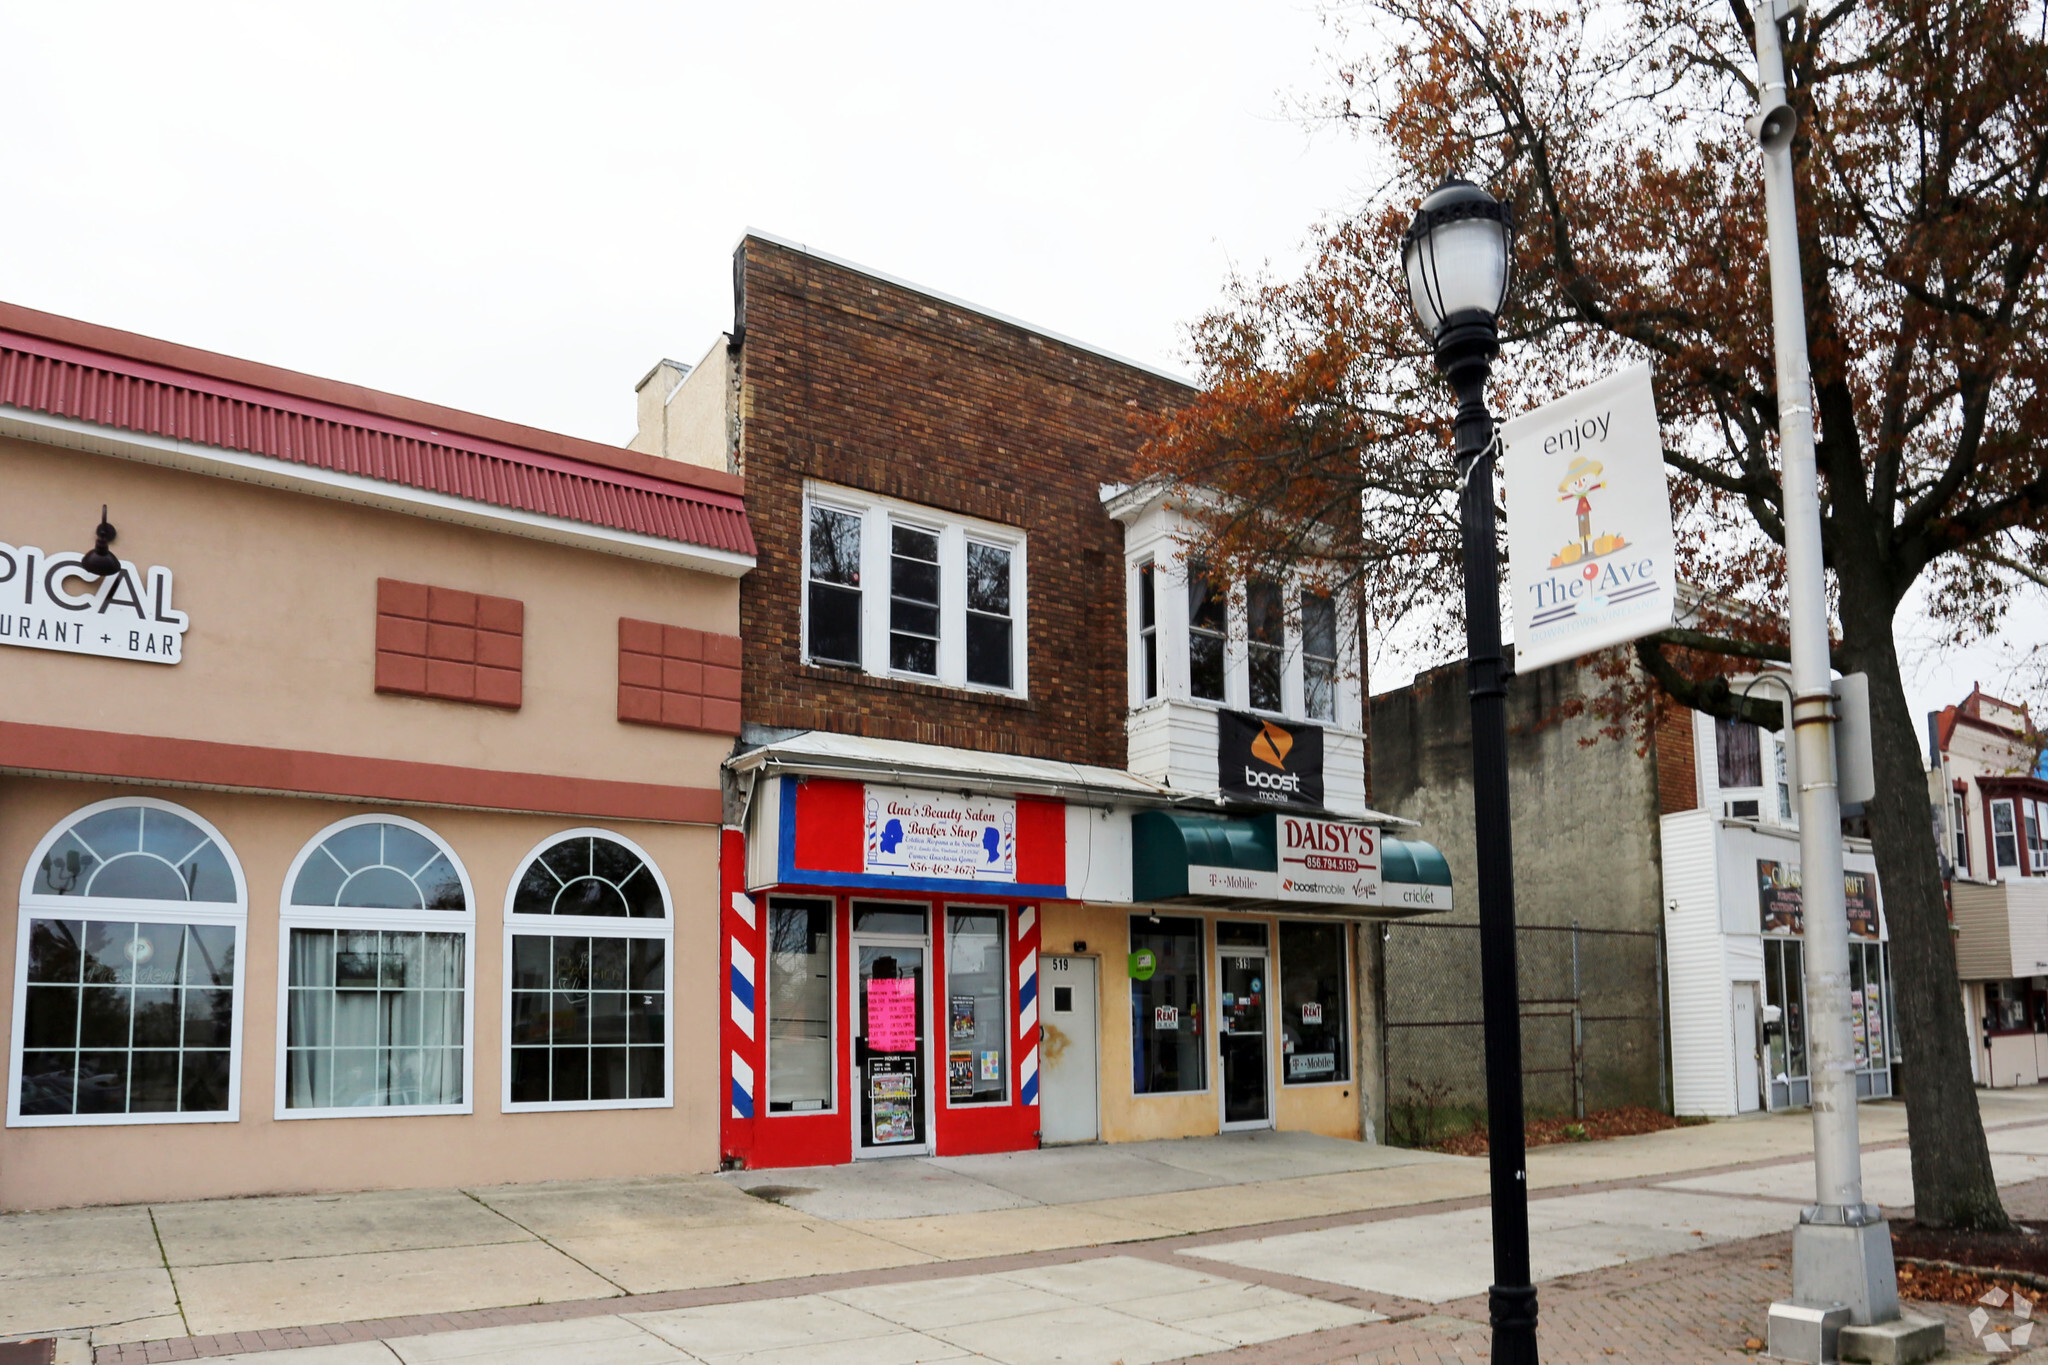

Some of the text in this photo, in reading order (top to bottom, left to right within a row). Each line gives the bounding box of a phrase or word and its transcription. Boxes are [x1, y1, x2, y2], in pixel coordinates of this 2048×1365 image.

[1543, 410, 1611, 455] enjoy
[1529, 557, 1654, 611] The Ave
[1530, 597, 1659, 643] DOWNTOWN VINELAND
[129, 630, 173, 656] BAR
[1245, 765, 1300, 793] boost
[1259, 790, 1288, 803] mobile
[887, 801, 996, 824] Ana's Beauty Salon
[907, 821, 978, 842] Barber Shop
[1284, 819, 1375, 856] DAISY'S
[909, 862, 976, 876] 856-462-4673
[1306, 856, 1357, 872] 856.794.5152
[1352, 878, 1377, 899] Virgin
[1403, 887, 1434, 904] cricket
[1052, 958, 1069, 971] 519
[1156, 1008, 1177, 1022] RENT
[1304, 1005, 1321, 1018] RENT
